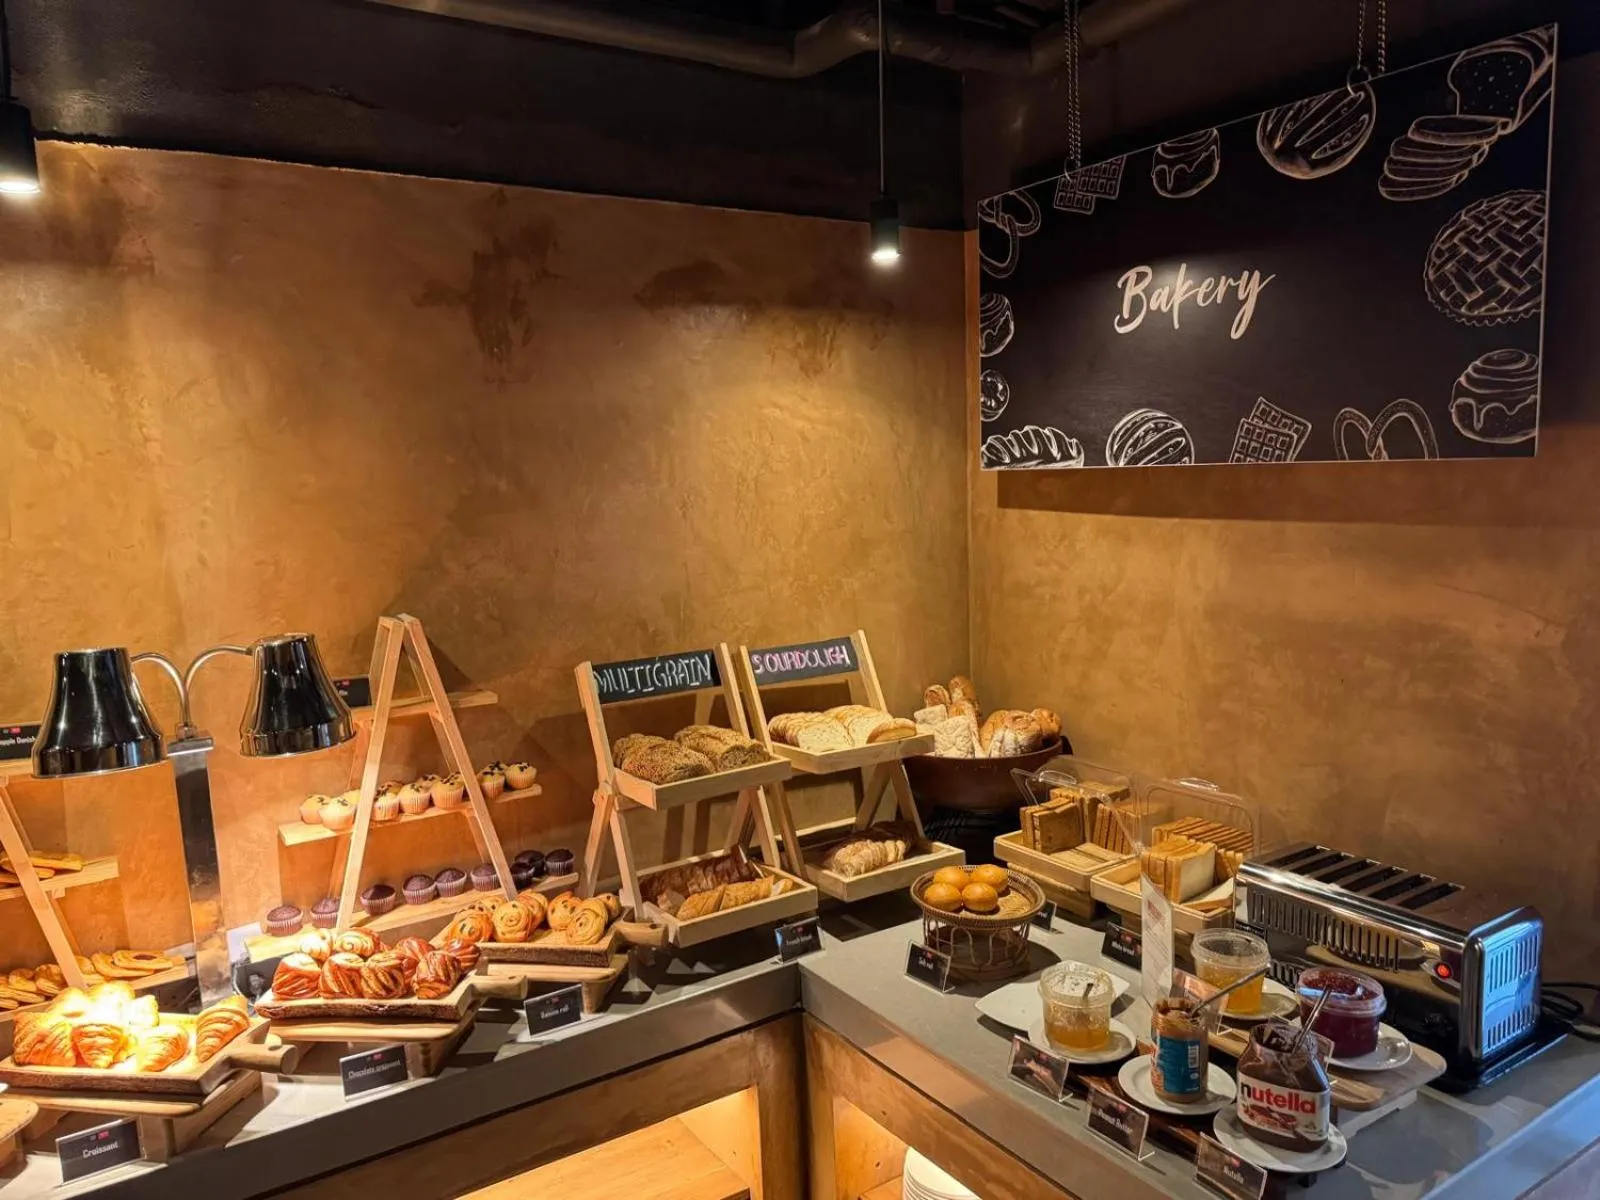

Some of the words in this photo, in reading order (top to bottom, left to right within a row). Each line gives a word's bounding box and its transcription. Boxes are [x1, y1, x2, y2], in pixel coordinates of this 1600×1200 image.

[1114, 263, 1276, 340] Bakery
[593, 653, 712, 693] MULTIGRAIN
[751, 645, 851, 674] SOURDOUGH
[1240, 1082, 1317, 1114] nutella
[82, 1141, 120, 1159] Croissant
